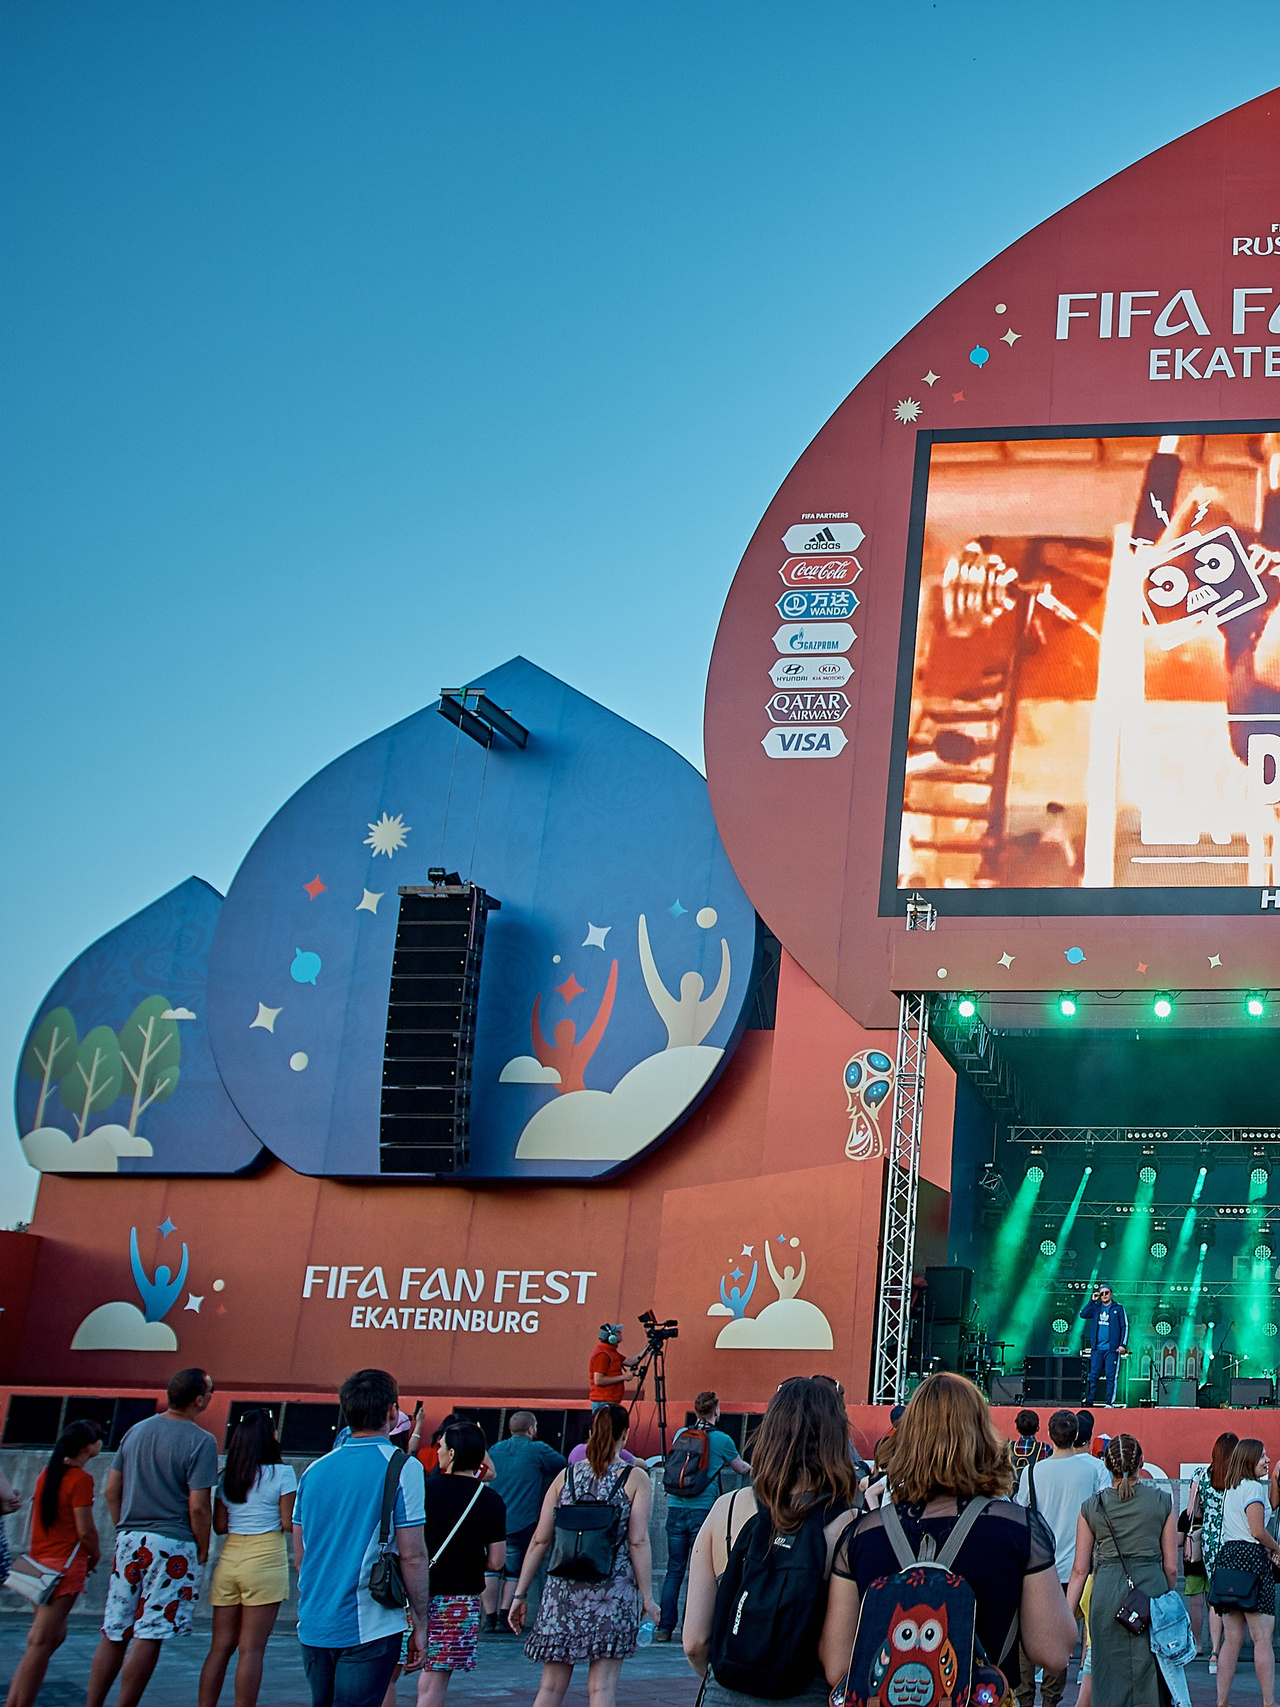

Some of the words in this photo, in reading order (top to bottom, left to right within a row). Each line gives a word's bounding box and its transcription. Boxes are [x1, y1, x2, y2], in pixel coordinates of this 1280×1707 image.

[1056, 290, 1211, 340] FIFA
[804, 541, 841, 551] adidas
[810, 592, 849, 607] 万达
[810, 607, 848, 616] WANDA
[803, 640, 839, 650] GAZPROM
[773, 694, 841, 714] QATAR
[788, 709, 841, 721] AIRWAYS
[776, 733, 830, 751] VISA
[302, 1266, 389, 1300] FIFA
[400, 1267, 485, 1302] FAN
[493, 1270, 597, 1305] FEST
[350, 1305, 540, 1334] EKATERINBURG
